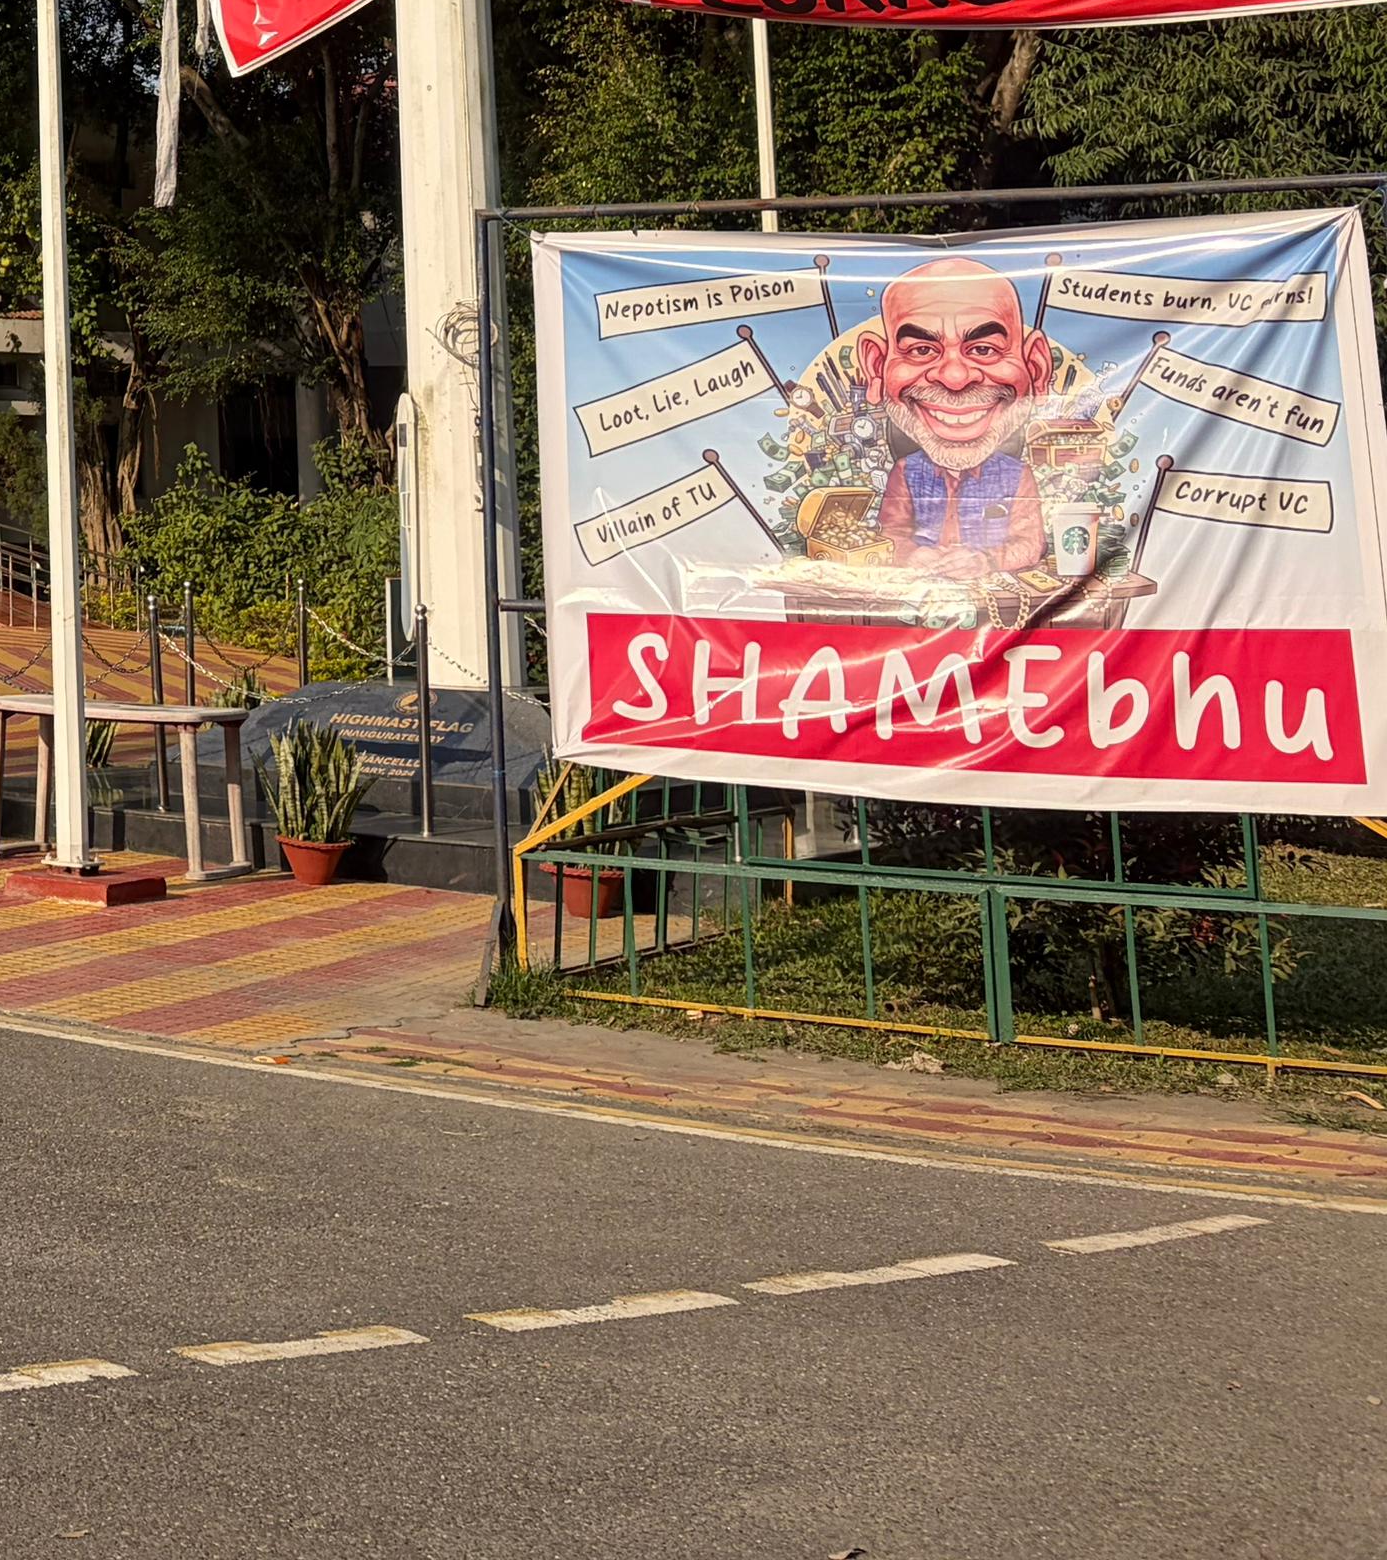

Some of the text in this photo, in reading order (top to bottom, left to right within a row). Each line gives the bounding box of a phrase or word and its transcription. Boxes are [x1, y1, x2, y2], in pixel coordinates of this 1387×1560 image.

[605, 279, 795, 321] Nepotism is Poison
[1058, 277, 1155, 306] Students
[1163, 290, 1217, 312] burn,
[1228, 292, 1253, 312] VC
[599, 360, 755, 431] Loot, Lie, Laugh
[1149, 356, 1325, 433] Funds aren't fun
[597, 482, 717, 543] Villain of TU
[1175, 481, 1309, 514] Corrupt VC
[330, 713, 419, 729] HIGHMAST
[612, 632, 1334, 761] SHAMEbhu
